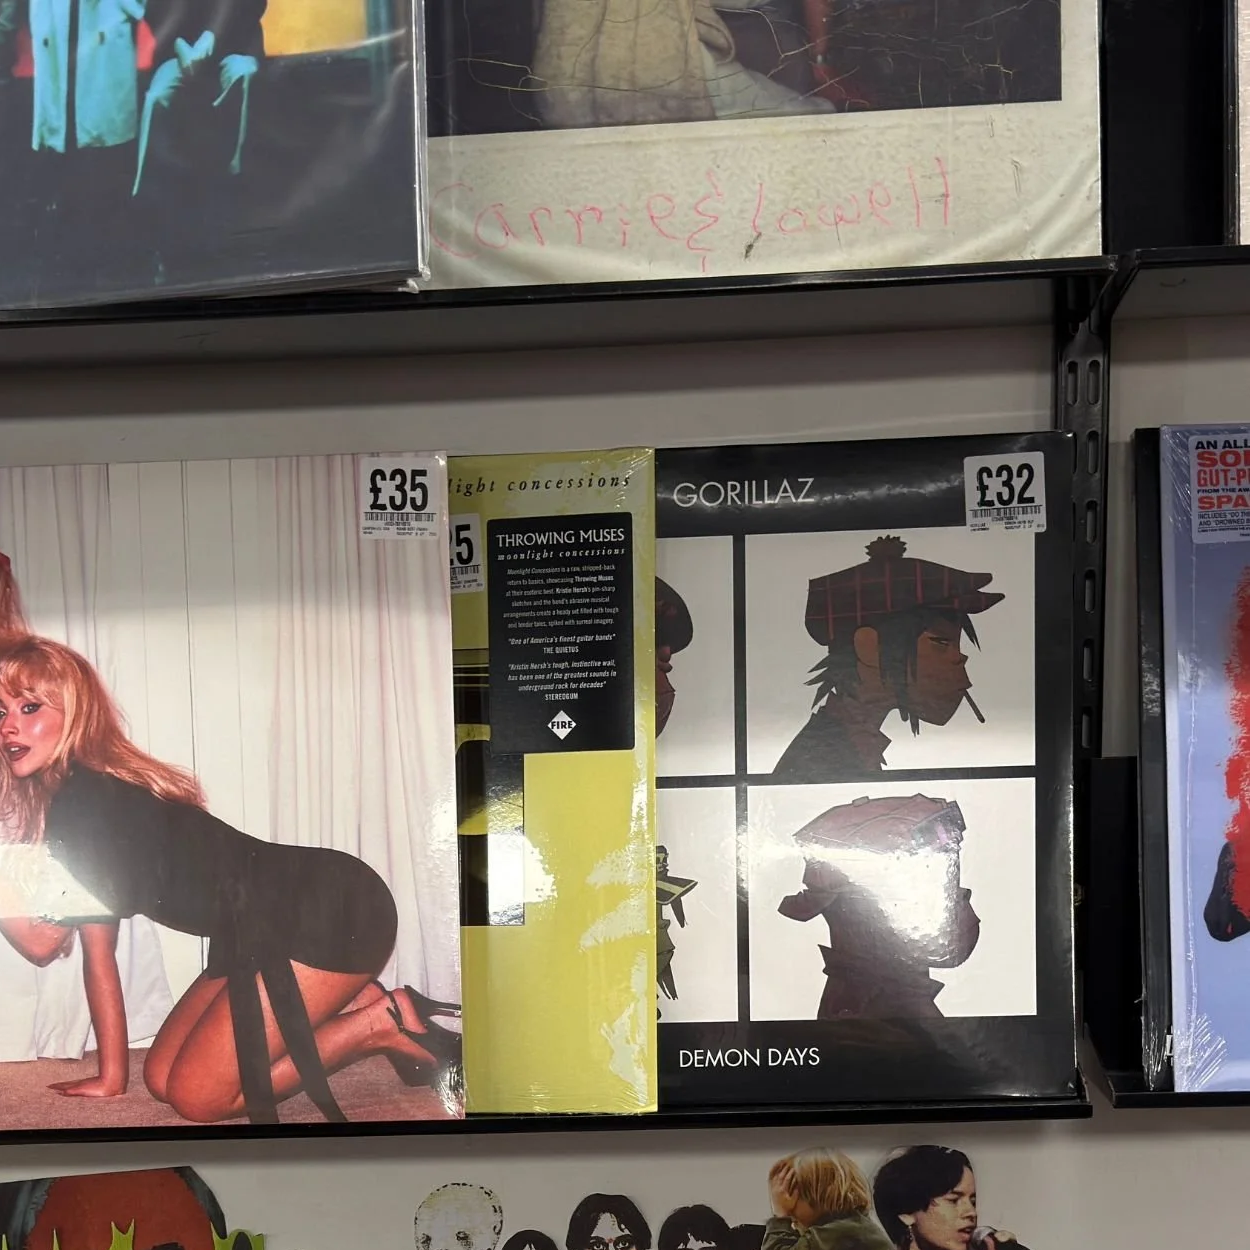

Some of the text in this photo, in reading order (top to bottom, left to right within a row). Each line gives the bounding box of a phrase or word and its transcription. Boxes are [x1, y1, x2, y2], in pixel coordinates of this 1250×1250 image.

[1195, 439, 1218, 450] AN
[507, 473, 631, 492] concessions
[977, 463, 1035, 508] £32
[1197, 468, 1250, 488] GUT-P
[369, 469, 428, 512] £35
[673, 477, 815, 508] GORILLAZ
[495, 528, 625, 548] THROWING MUSES
[497, 546, 625, 561] moonlight concessions
[544, 693, 579, 701] STEREOGUM
[551, 720, 574, 730] FIRE
[679, 1047, 820, 1068] DEMON DAYS
